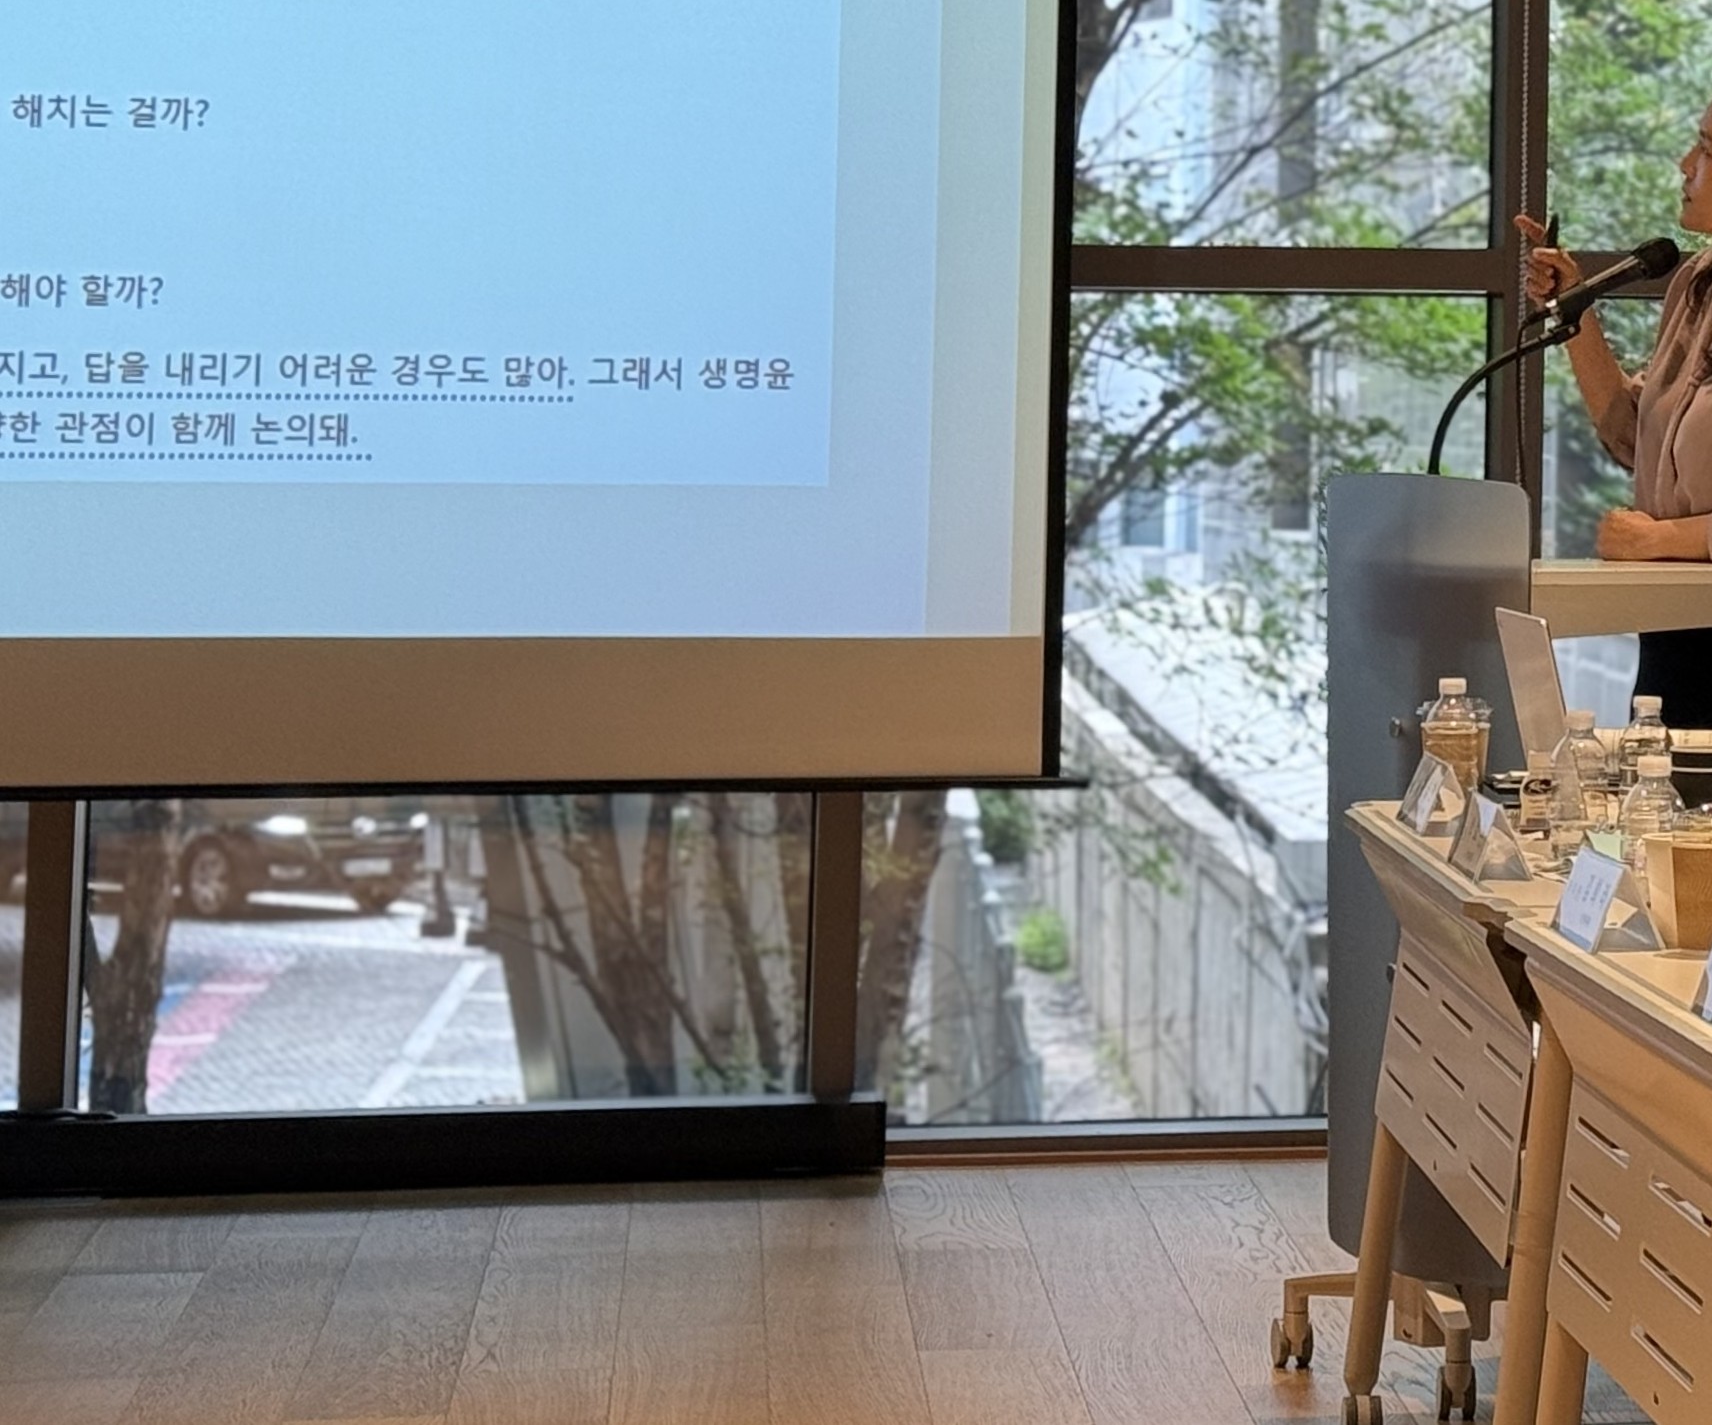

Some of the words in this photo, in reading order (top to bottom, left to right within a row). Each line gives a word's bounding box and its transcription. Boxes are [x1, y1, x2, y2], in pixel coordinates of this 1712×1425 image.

[12, 95, 114, 130] 해치는
[127, 97, 211, 133] 걸까?
[0, 274, 69, 310] 해야
[81, 275, 165, 311] 할까?
[0, 351, 70, 387] 지고,
[84, 352, 151, 385] 답을
[165, 353, 263, 389] 내리기
[279, 354, 378, 389] 어려운
[391, 355, 491, 390] 경우도
[504, 357, 576, 391] 많아.
[587, 358, 684, 392] 그래서
[698, 359, 796, 392] 생명윤
[0, 411, 43, 445] 한
[54, 412, 156, 447] 관점이
[171, 413, 237, 448] 함께
[251, 413, 359, 449] 논의돼.
